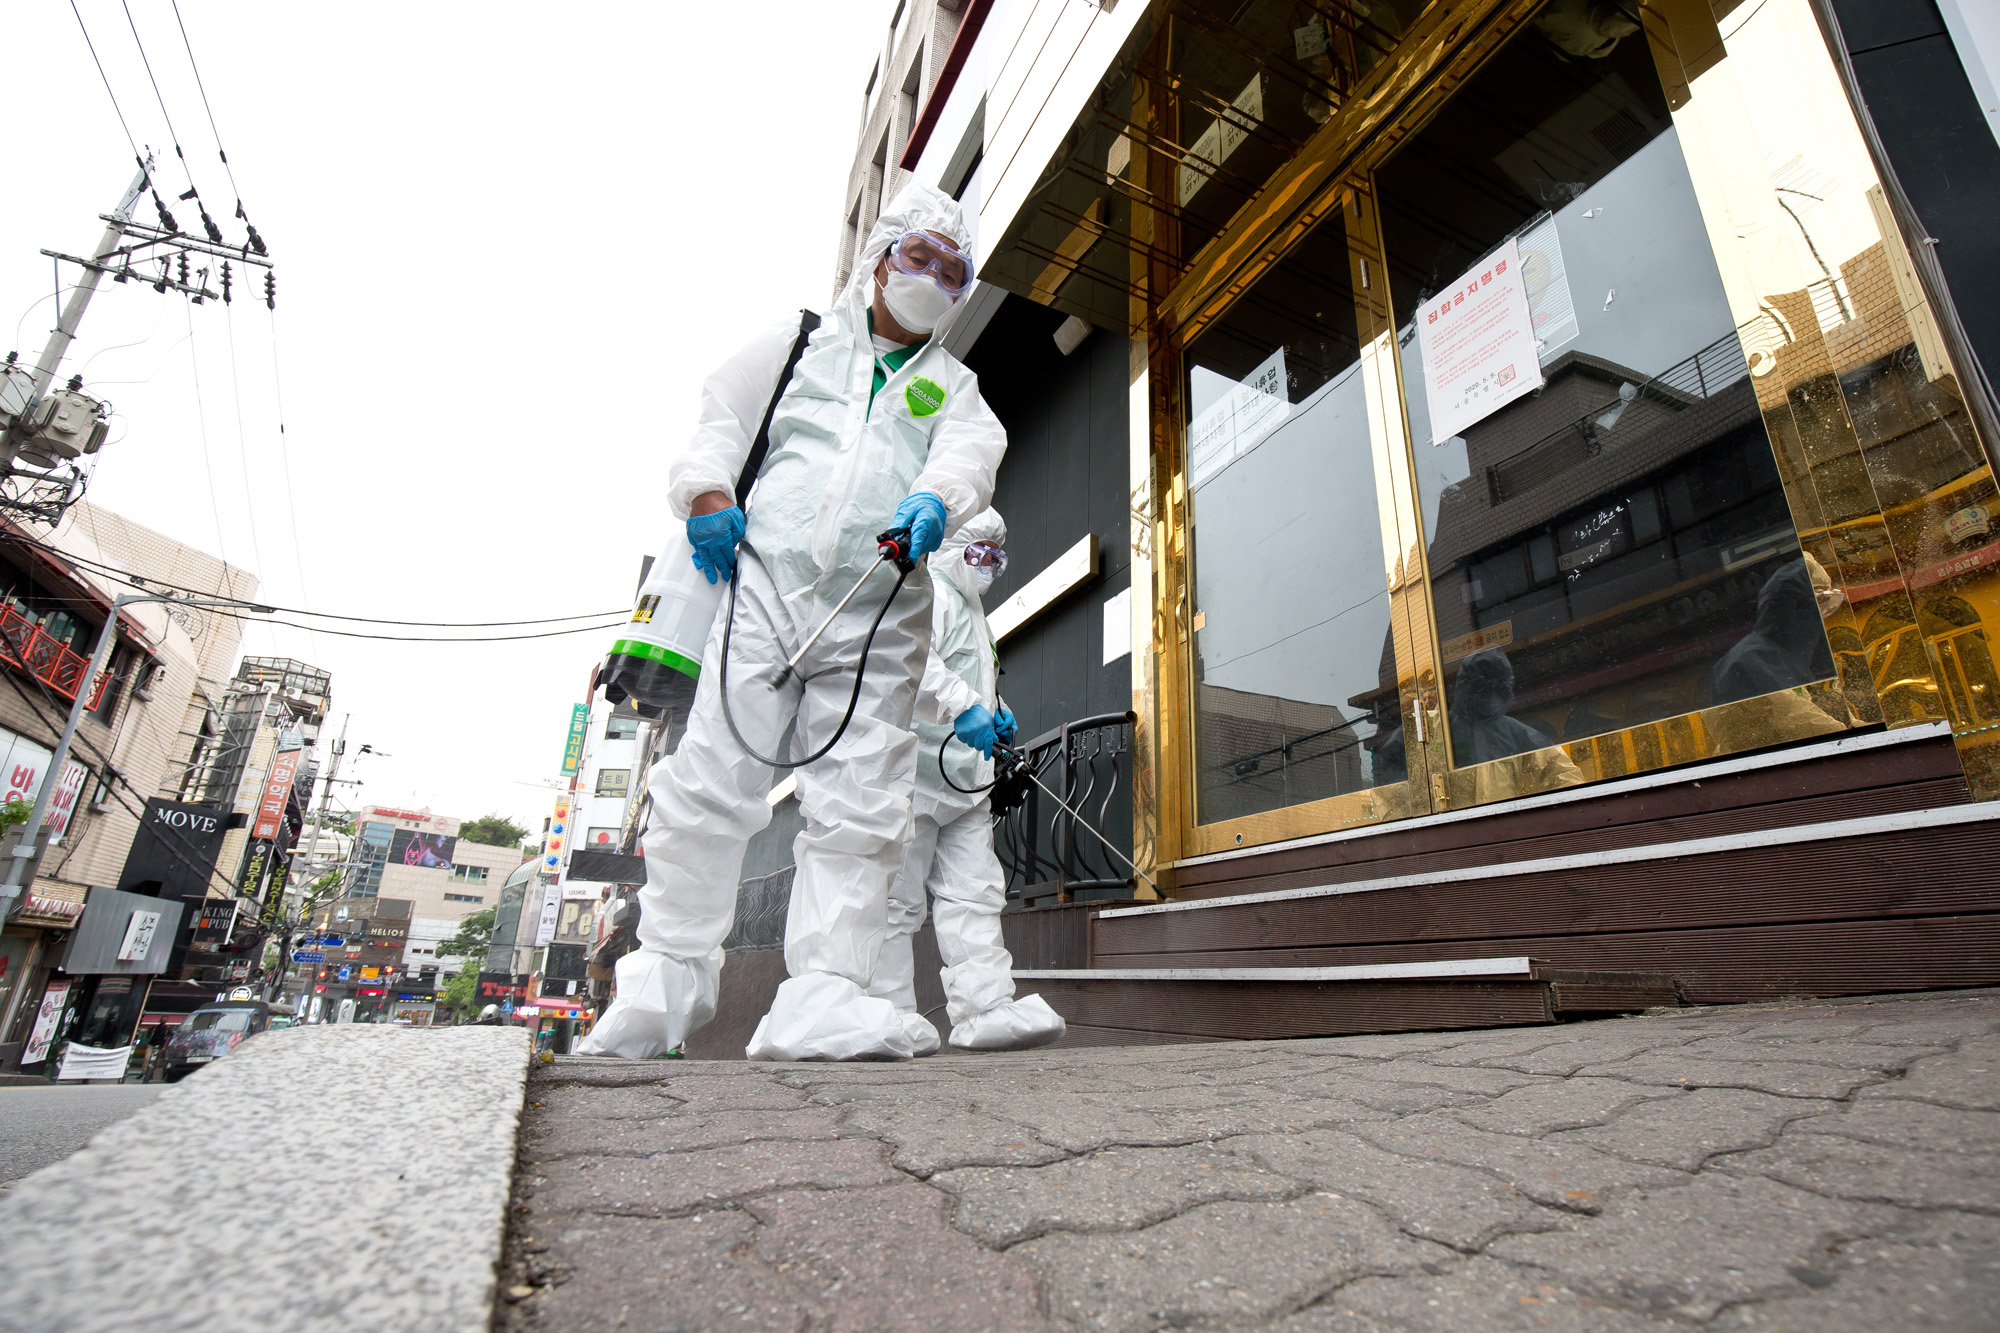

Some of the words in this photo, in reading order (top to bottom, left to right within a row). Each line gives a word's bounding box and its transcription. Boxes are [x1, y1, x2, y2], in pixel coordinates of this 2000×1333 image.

[1428, 260, 1507, 325] 집합금지명령
[909, 384, 940, 408] MODA3000
[63, 766, 85, 790] ICE
[263, 754, 295, 816] 소명약국
[53, 787, 76, 811] USIC
[155, 808, 217, 834] MOVE
[203, 907, 233, 918] KING
[207, 919, 230, 929] PUB
[371, 928, 404, 937] HELIOS
